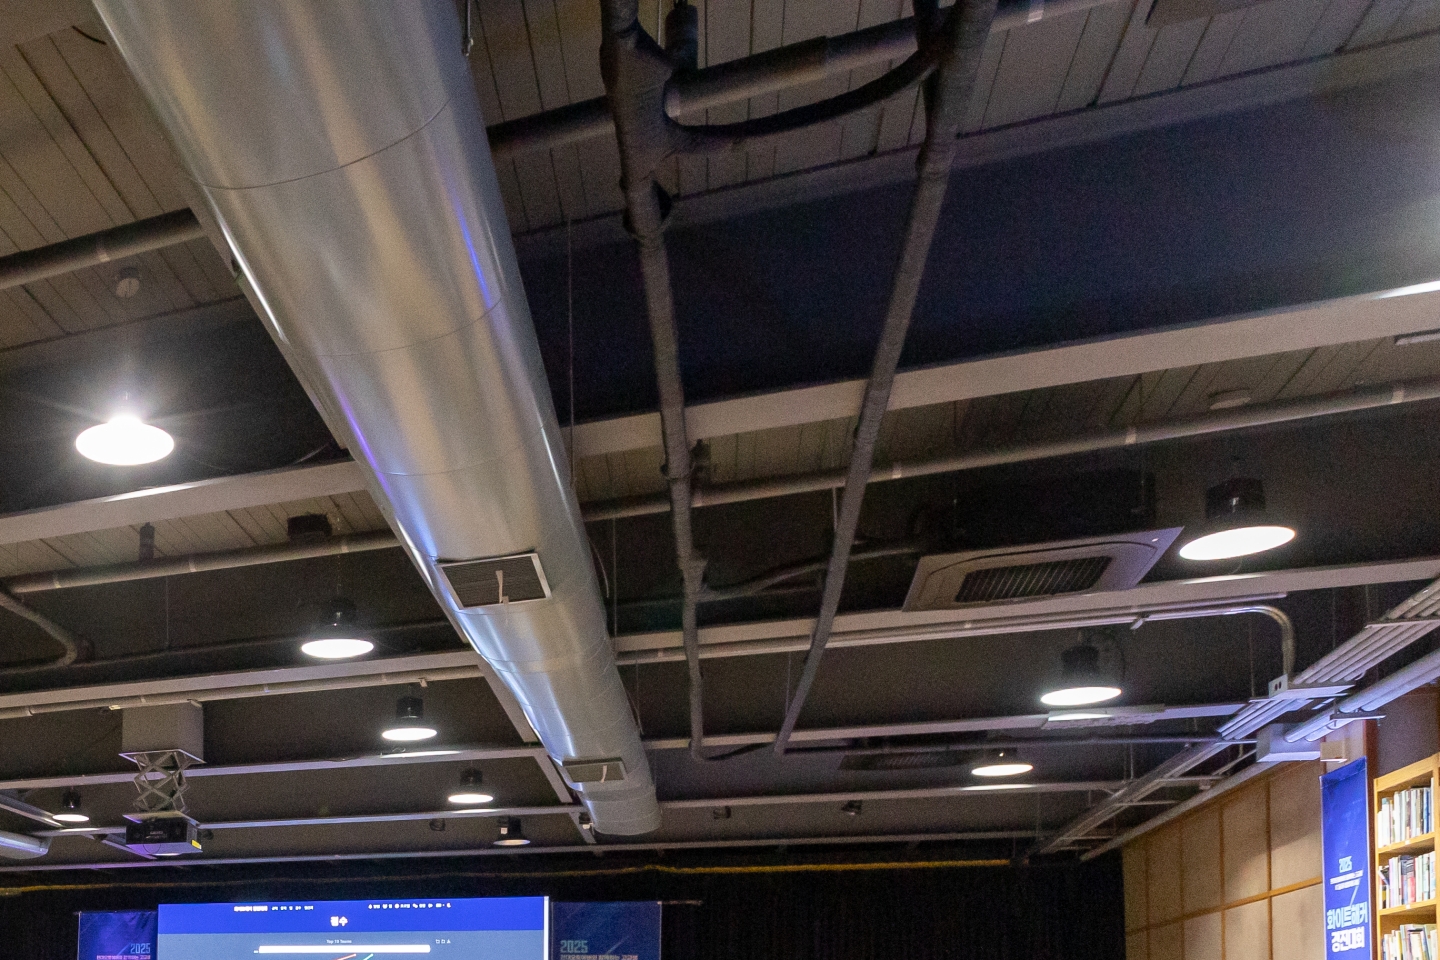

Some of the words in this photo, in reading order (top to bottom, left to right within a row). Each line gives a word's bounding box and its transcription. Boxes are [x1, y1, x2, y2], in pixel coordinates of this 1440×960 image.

[1327, 902, 1368, 929] 화이트해커
[130, 943, 151, 954] 2025
[560, 940, 588, 953] 2025
[1331, 927, 1365, 952] 경진대회
